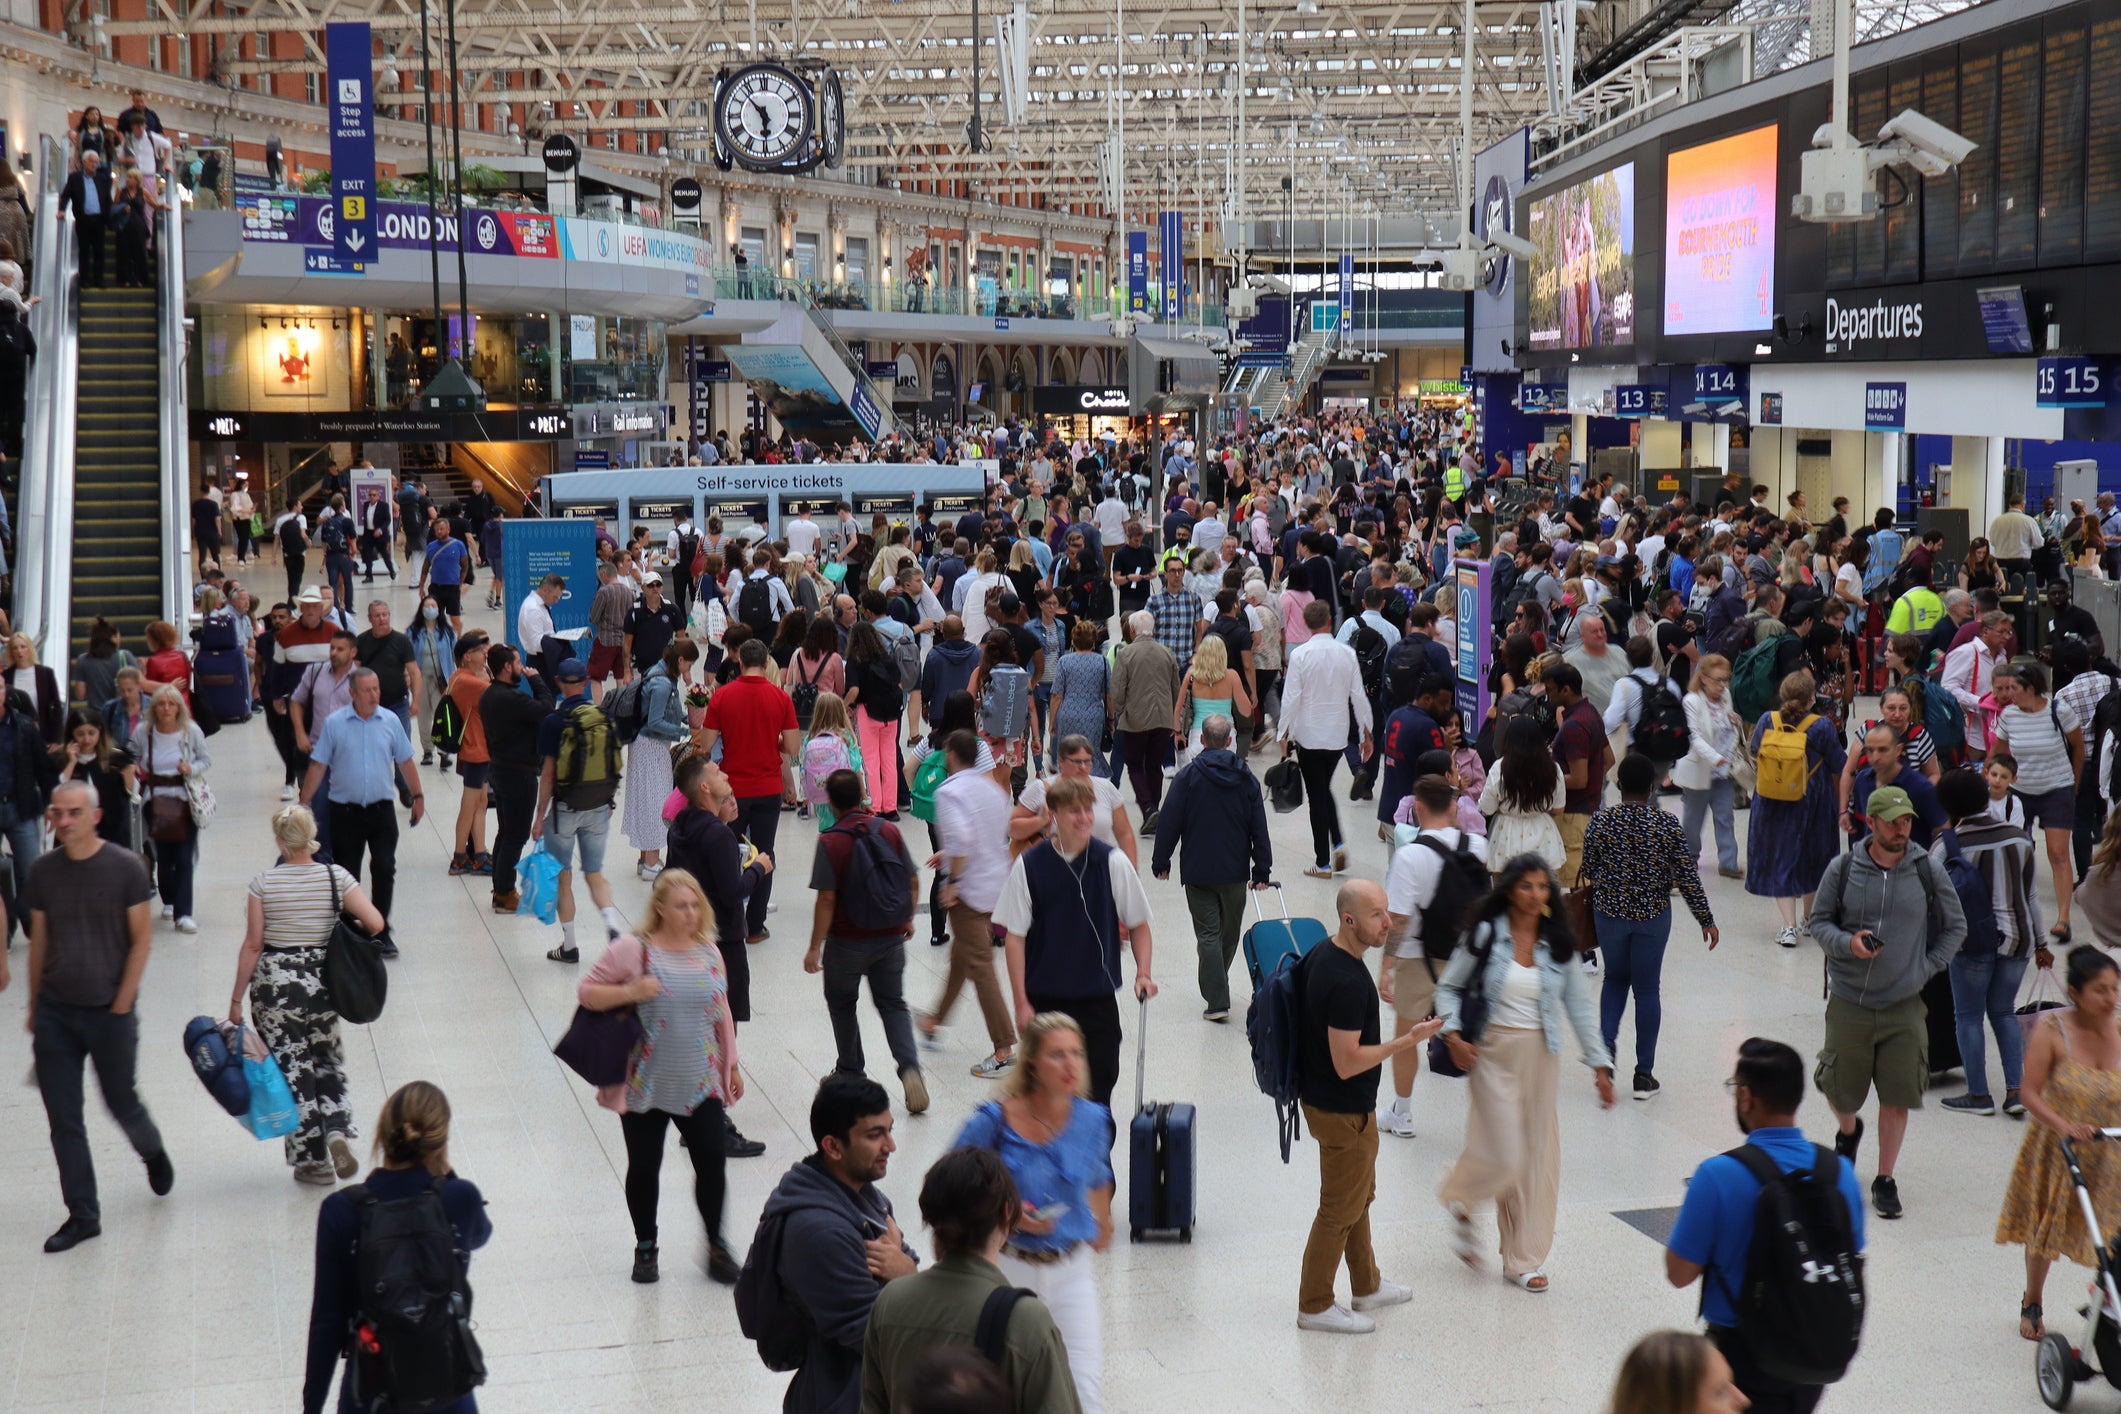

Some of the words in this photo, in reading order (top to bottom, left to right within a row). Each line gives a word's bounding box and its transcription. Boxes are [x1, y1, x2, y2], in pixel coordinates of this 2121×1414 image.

[341, 106, 361, 116] Step
[342, 116, 360, 126] free
[337, 129, 366, 137] access
[545, 149, 572, 157] BENUGO
[342, 180, 365, 190] EXIT
[348, 200, 359, 216] 3
[1682, 198, 1697, 224] GO
[1700, 188, 1732, 222] DOWN
[1734, 183, 1757, 213] FOR
[376, 213, 458, 242] LONDON
[1678, 216, 1759, 256] BOURNEMOUTH
[624, 234, 648, 256] UEFA
[648, 238, 681, 262] WOMEN'S
[680, 242, 694, 264] EURO
[1701, 252, 1732, 282] PRIDE
[1757, 262, 1769, 316] 4
[1826, 297, 1923, 350] Departures
[1696, 373, 1704, 392] 14
[1710, 372, 1736, 392] 14
[2039, 368, 2055, 394] 15
[2064, 366, 2100, 394] 15
[1525, 388, 1544, 402] 12
[1621, 390, 1644, 408] 13
[537, 416, 558, 434] PRET
[614, 414, 625, 431] Rail
[1874, 412, 1886, 422] Platform
[215, 418, 234, 435] PRET
[320, 422, 343, 431] Freshly
[345, 422, 375, 432] prepared
[383, 422, 415, 430] Waterloo
[416, 421, 441, 430] Station
[697, 475, 788, 491] Self-service
[792, 474, 844, 489] tickets
[720, 504, 743, 512] TICKETS
[1008, 675, 1017, 702] KARI
[1003, 703, 1013, 736] TRAA
[1388, 720, 1402, 749] 2
[1430, 728, 1445, 748] 2
